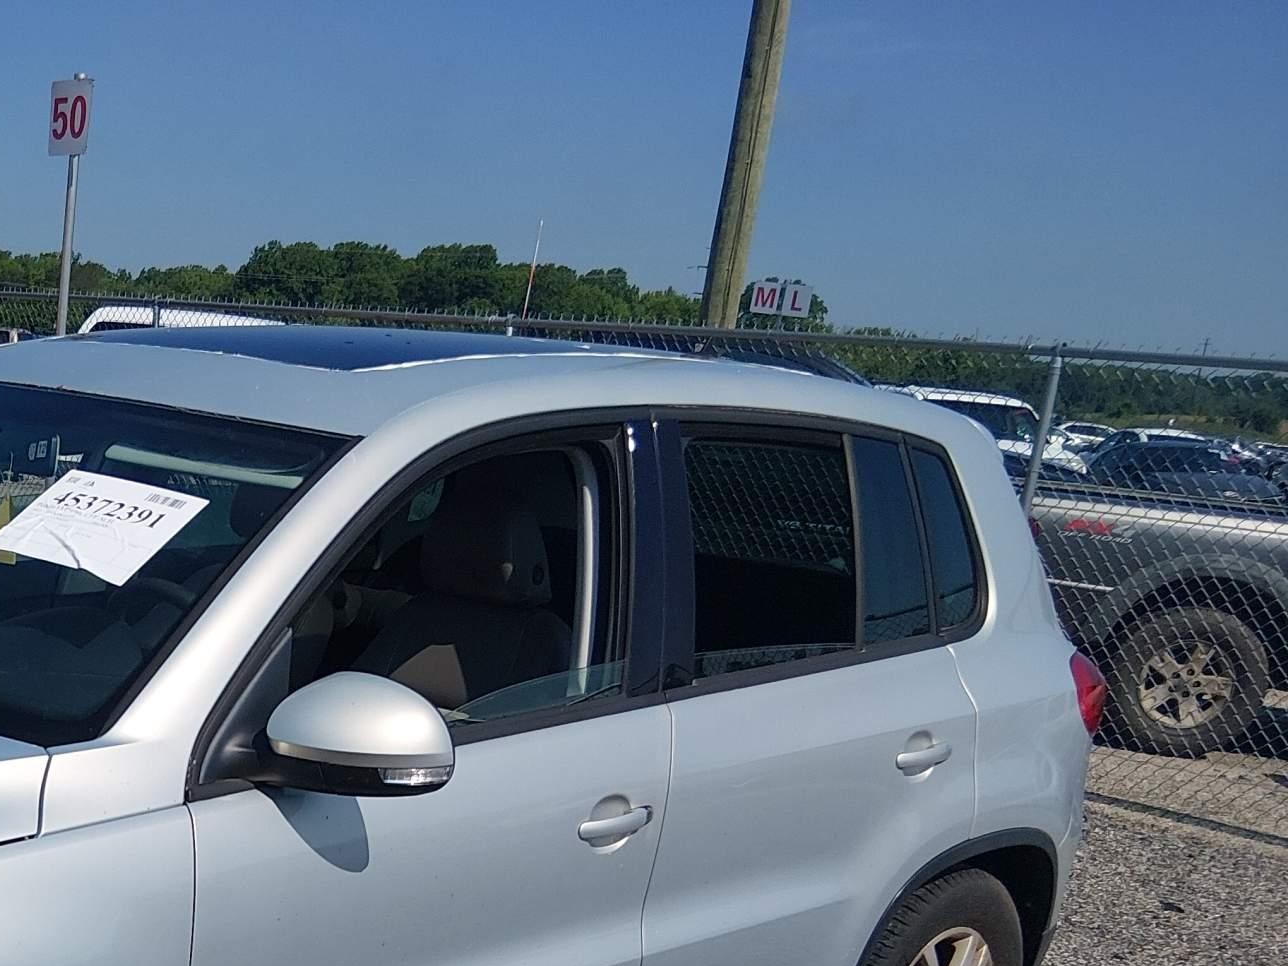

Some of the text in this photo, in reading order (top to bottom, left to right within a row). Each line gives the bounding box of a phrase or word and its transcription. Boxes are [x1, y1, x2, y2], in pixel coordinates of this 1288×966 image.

[52, 95, 87, 140] 50
[754, 286, 777, 309] M
[790, 290, 802, 312] L
[54, 491, 166, 529] 45372391
